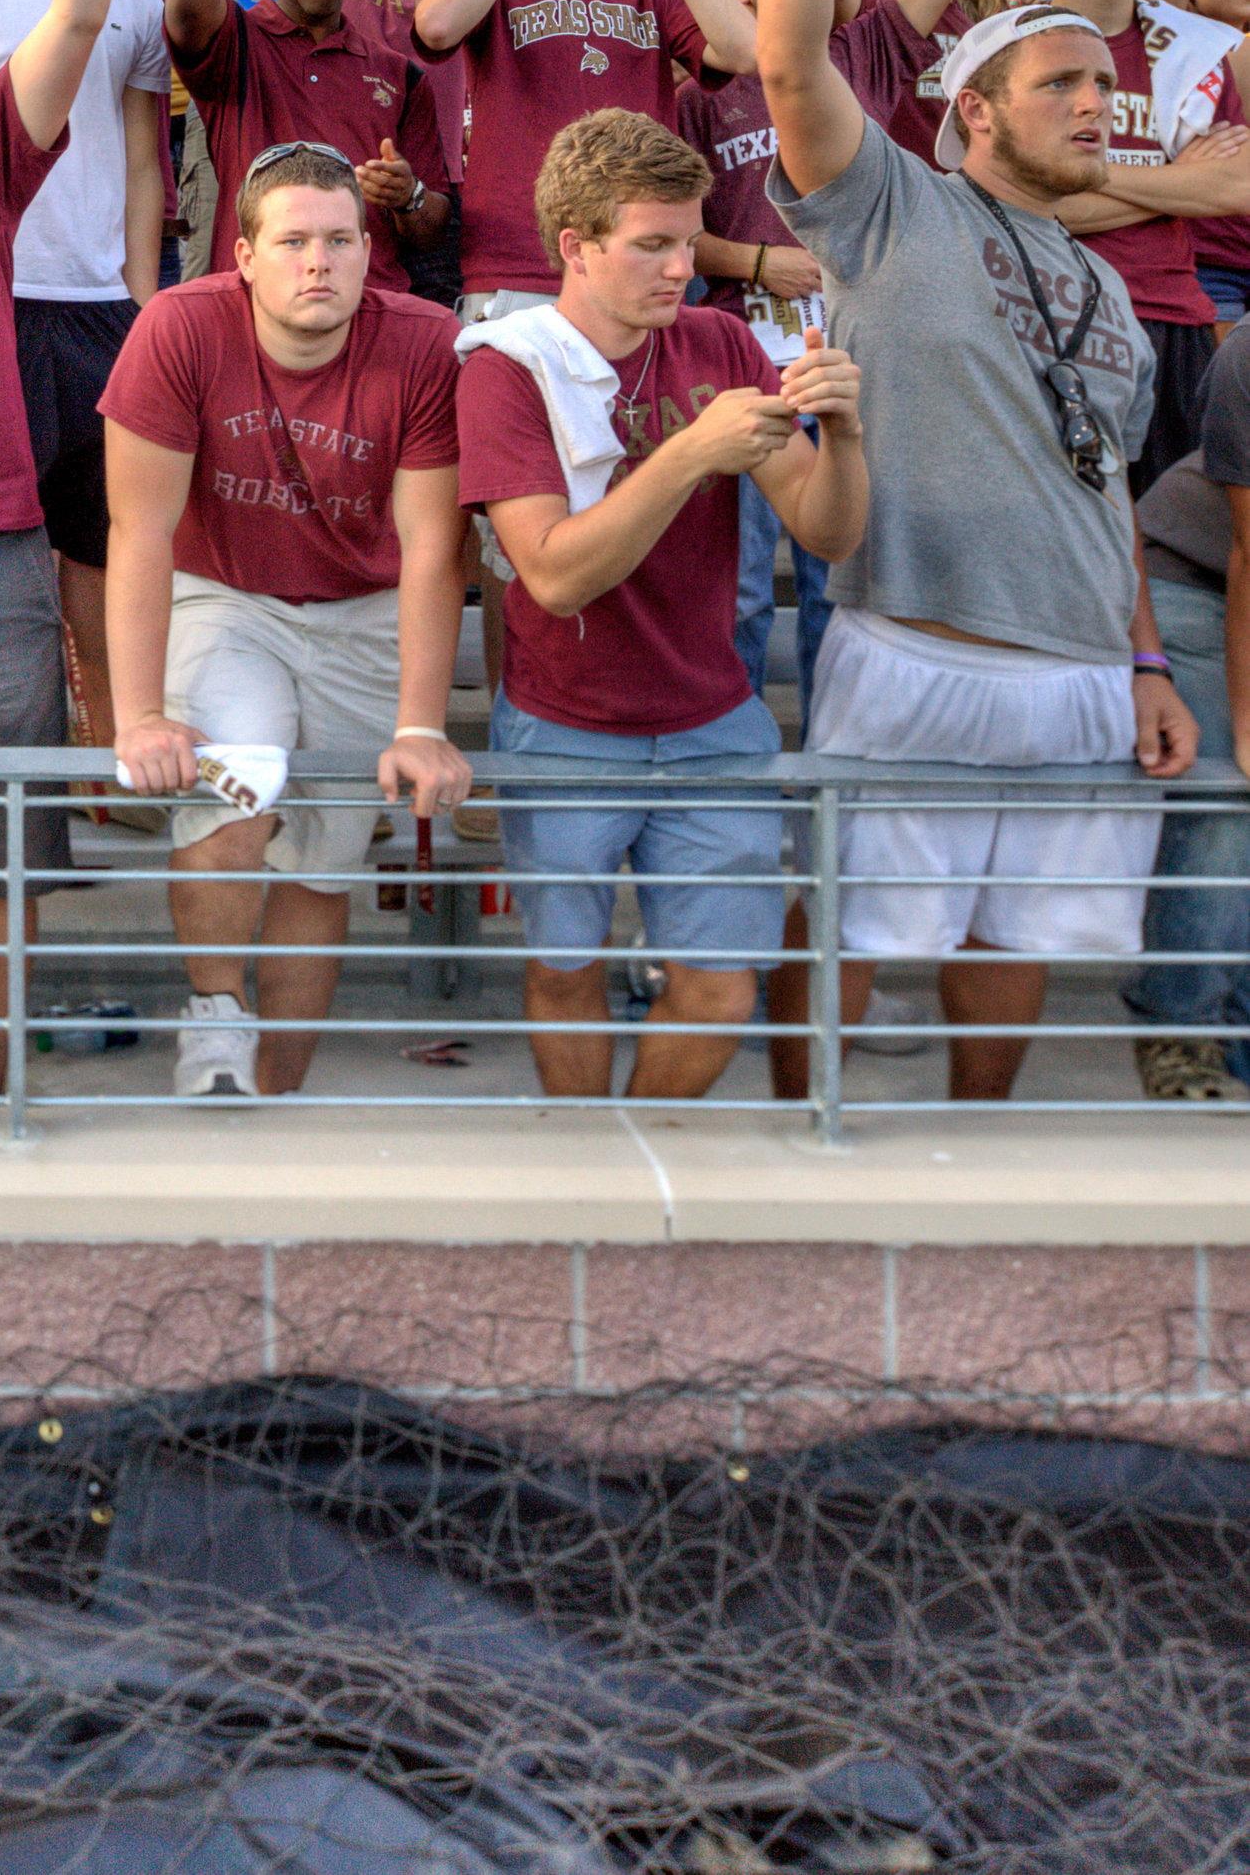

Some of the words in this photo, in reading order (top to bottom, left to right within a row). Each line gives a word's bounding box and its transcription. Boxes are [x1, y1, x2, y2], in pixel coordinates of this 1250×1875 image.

[508, 0, 590, 50] TEXAS
[588, 0, 661, 49] STATE
[715, 127, 780, 171] TEXA
[289, 418, 375, 461] STATE
